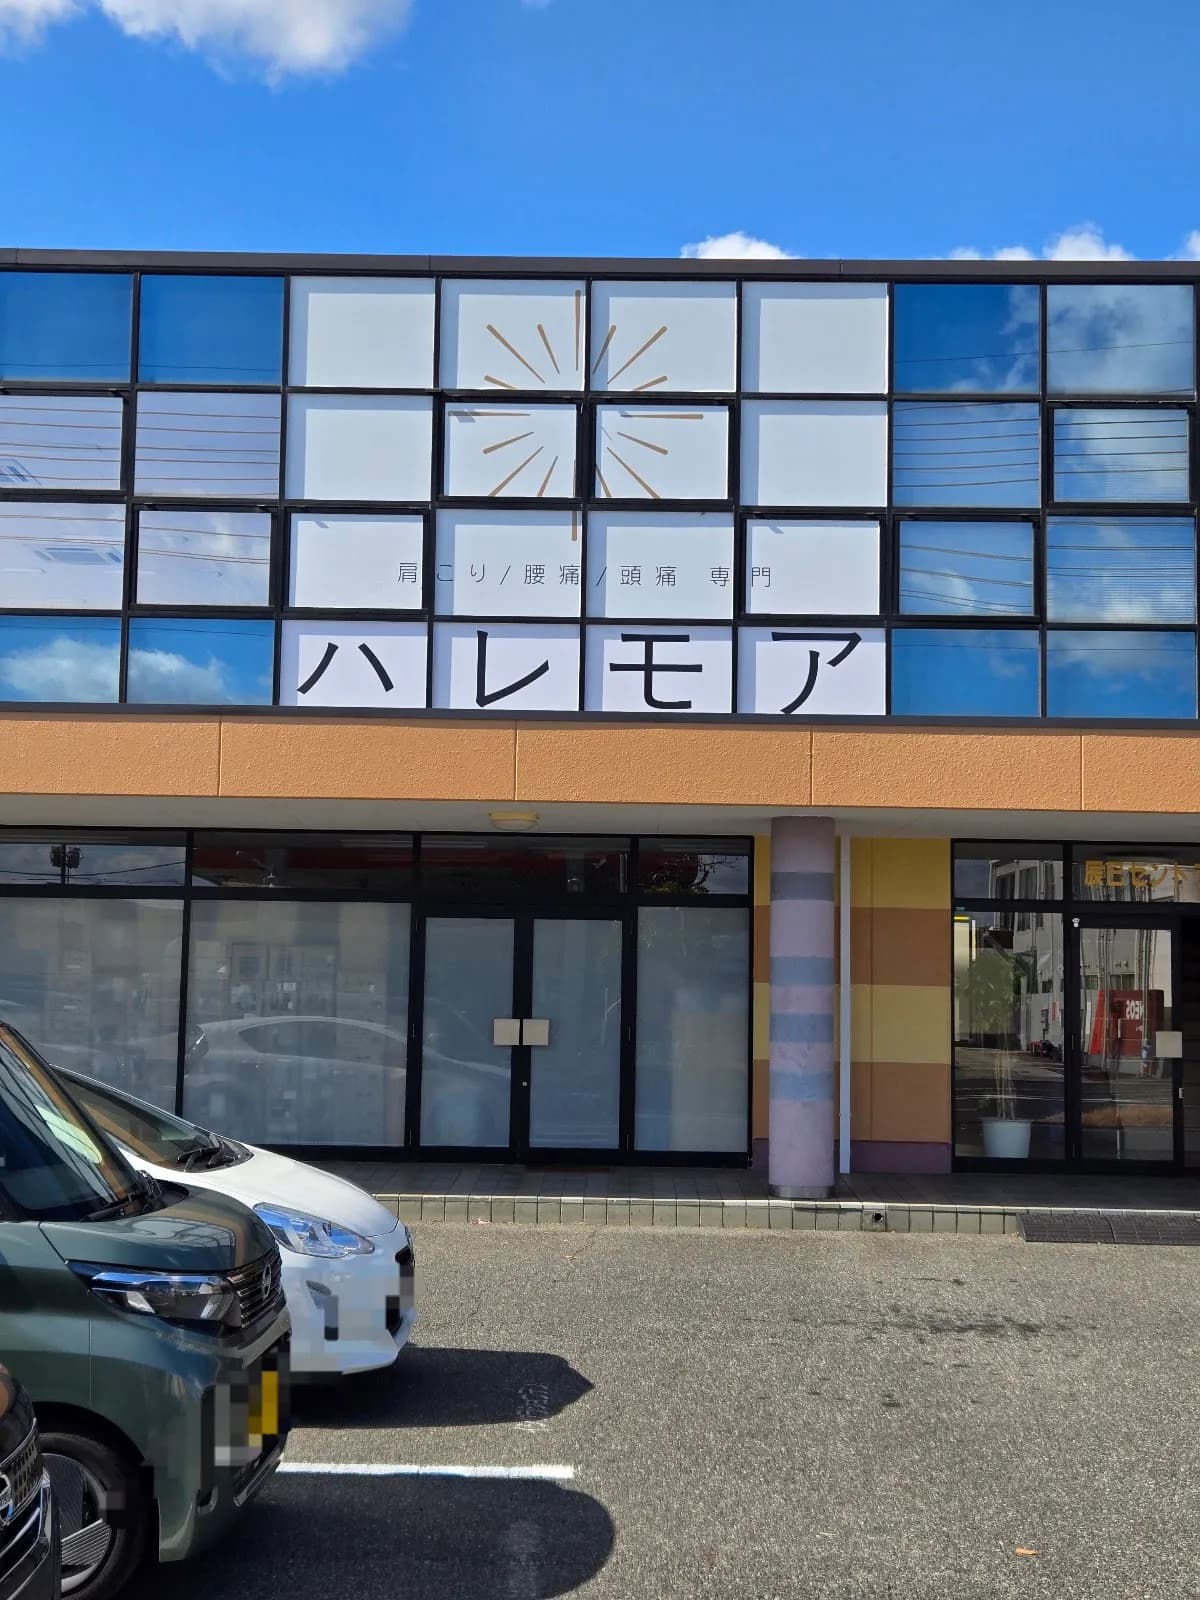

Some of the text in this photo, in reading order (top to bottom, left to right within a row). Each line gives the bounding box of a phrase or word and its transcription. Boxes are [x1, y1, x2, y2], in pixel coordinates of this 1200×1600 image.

[397, 562, 771, 588] 肩こり/腰痛/頭痛 専門
[297, 630, 862, 715] ハレモア
